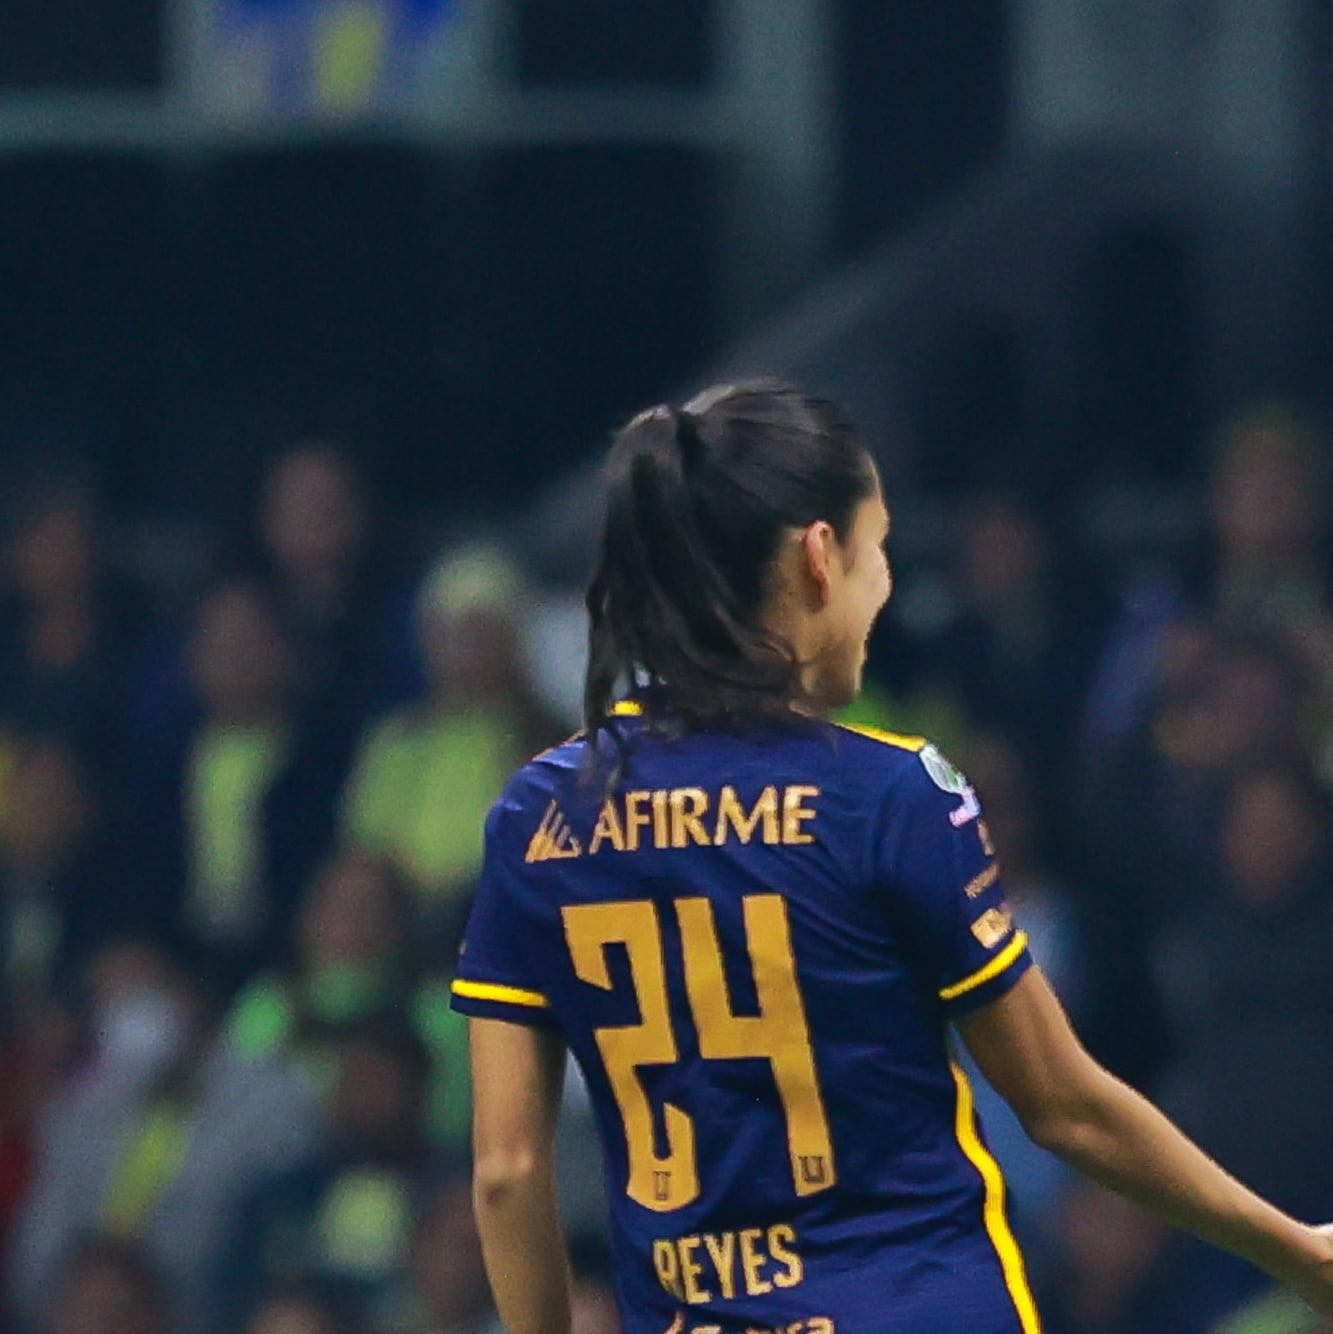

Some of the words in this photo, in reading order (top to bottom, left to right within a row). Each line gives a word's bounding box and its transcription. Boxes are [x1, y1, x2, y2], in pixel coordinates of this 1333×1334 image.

[588, 784, 821, 855] AFIRME
[561, 893, 838, 1213] 24
[652, 1223, 804, 1305] REYES
